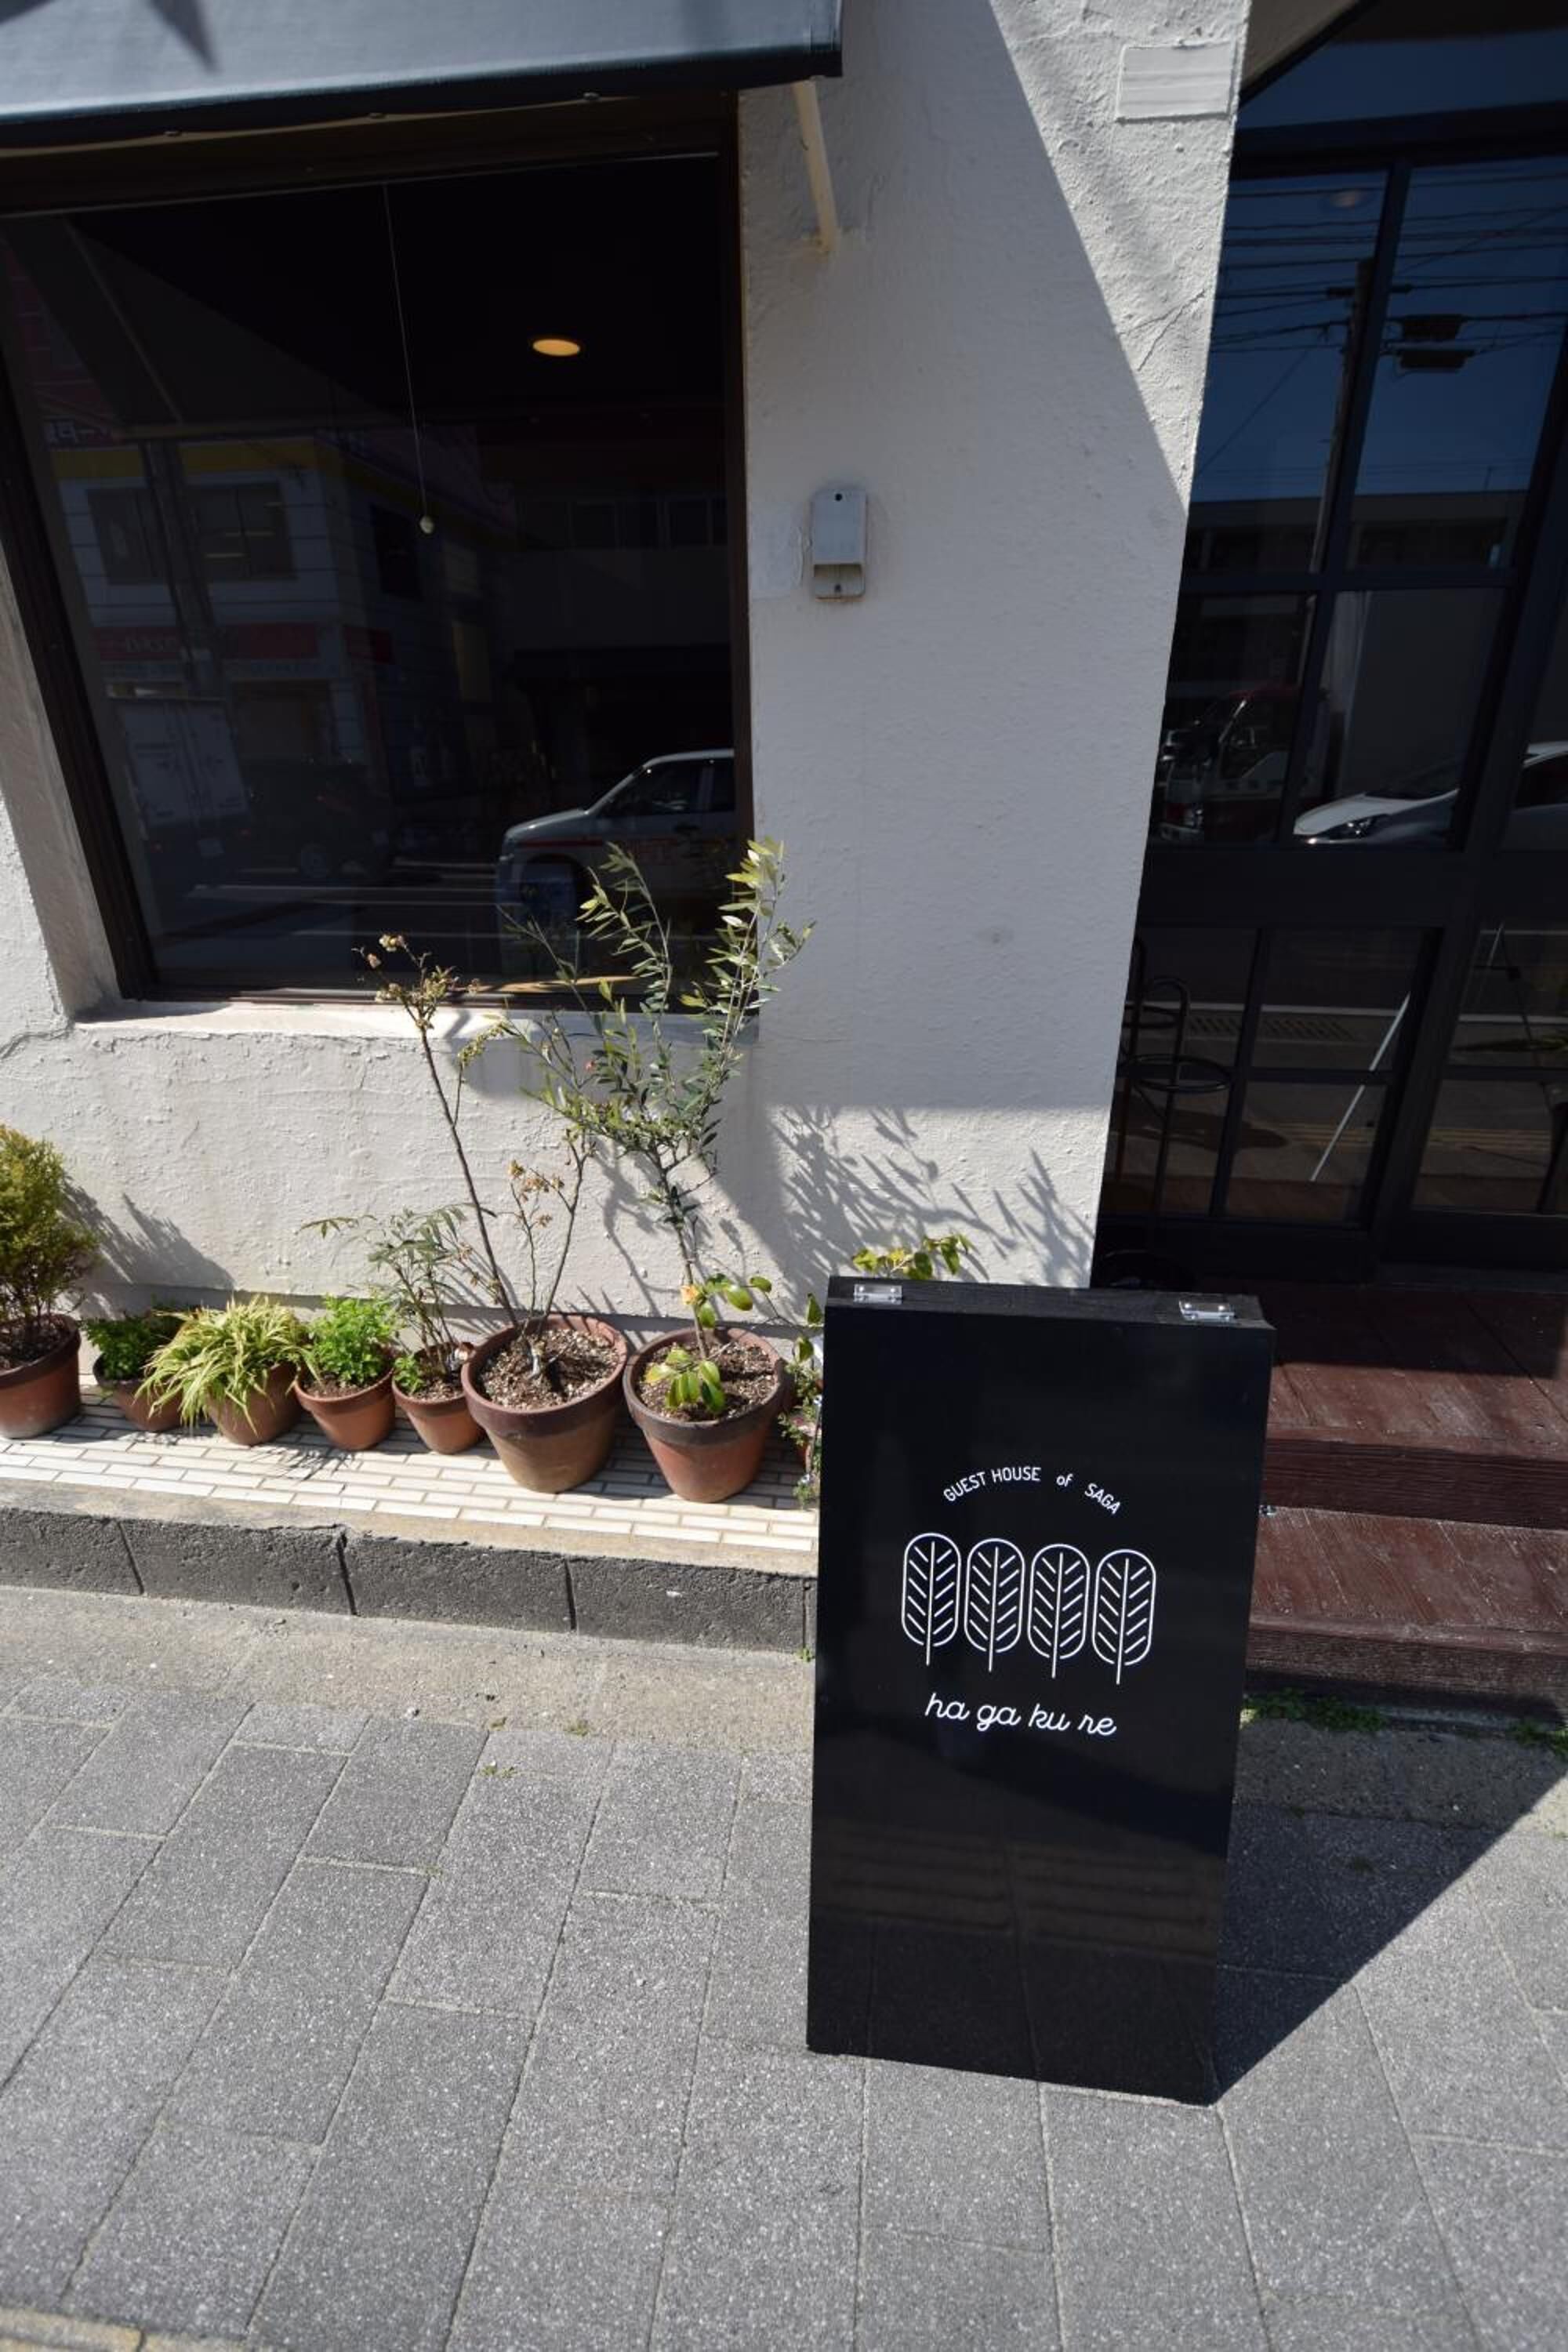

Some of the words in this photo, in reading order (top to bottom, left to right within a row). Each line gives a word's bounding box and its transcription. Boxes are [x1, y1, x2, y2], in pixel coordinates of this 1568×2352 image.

[943, 1471, 985, 1502] GUEST
[990, 1465, 1042, 1483] HOUSE
[1056, 1473, 1073, 1487] of
[1084, 1483, 1121, 1515] SAGA
